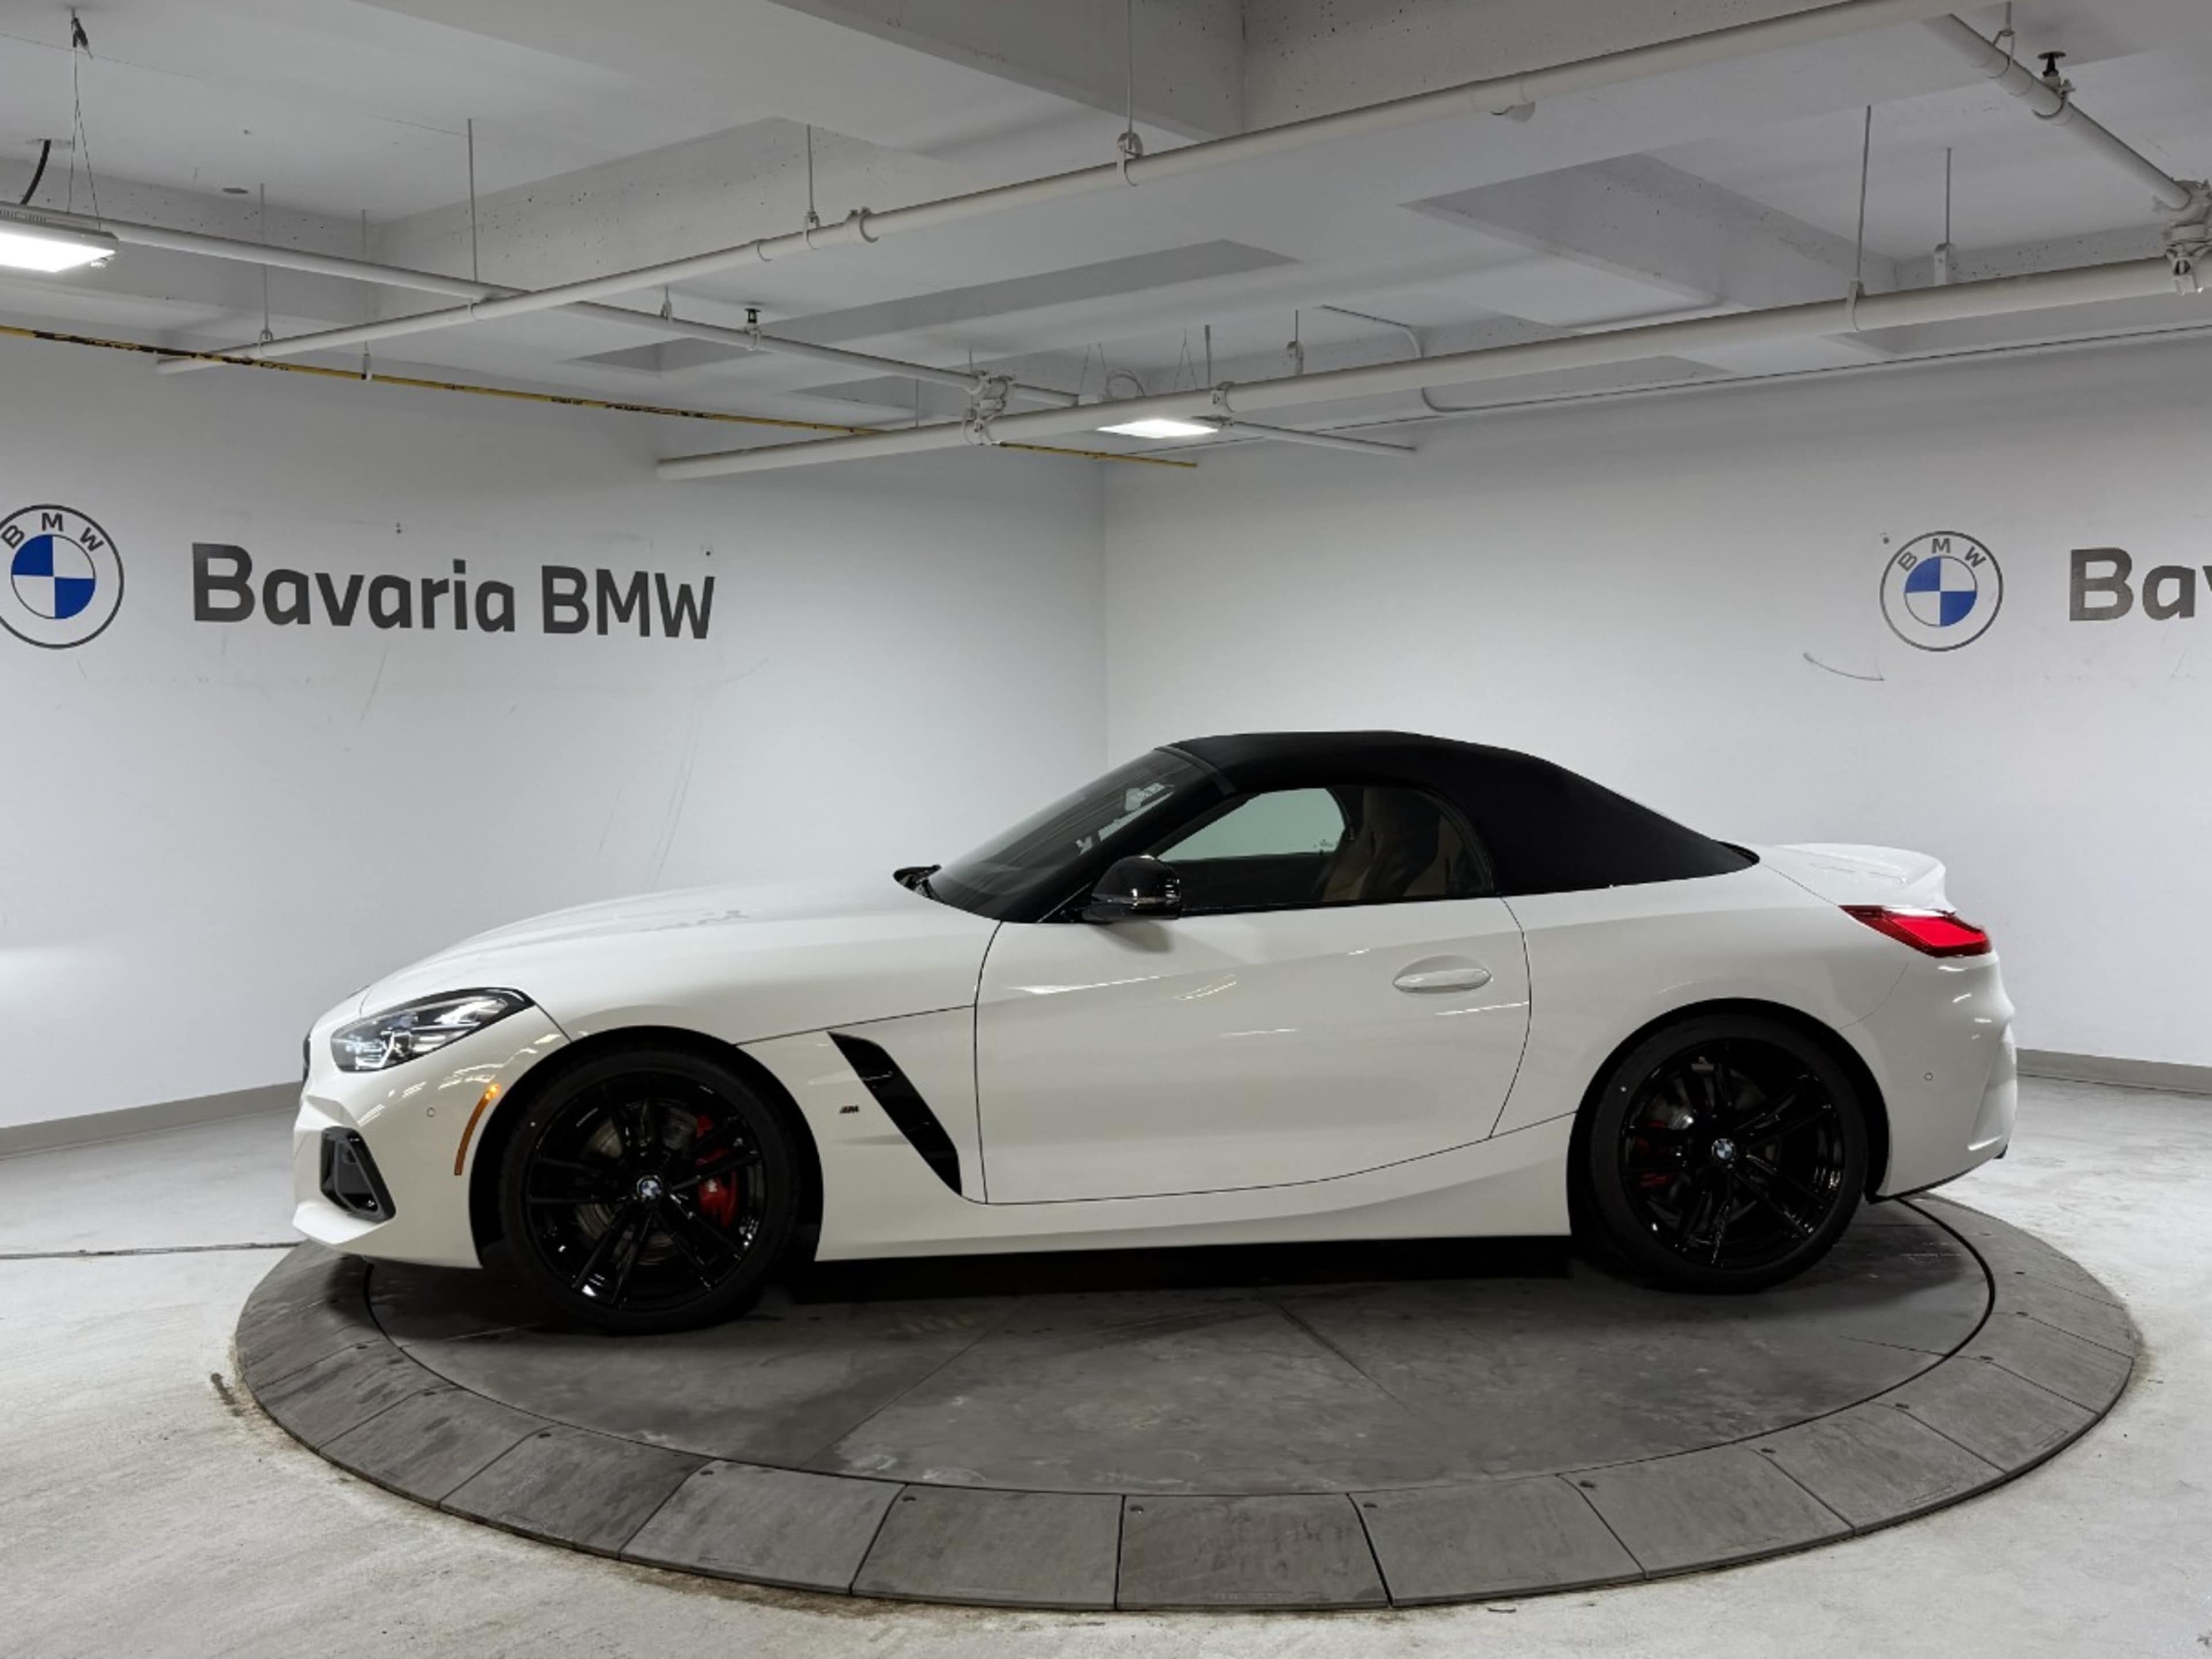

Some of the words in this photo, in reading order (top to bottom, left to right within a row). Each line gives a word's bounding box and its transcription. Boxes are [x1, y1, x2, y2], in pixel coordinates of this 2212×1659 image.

[1, 512, 104, 552] BMW
[1897, 538, 1986, 571] BMW
[192, 542, 515, 633] Bavaria
[541, 565, 715, 639] BMW
[2070, 547, 2212, 621] Ba
